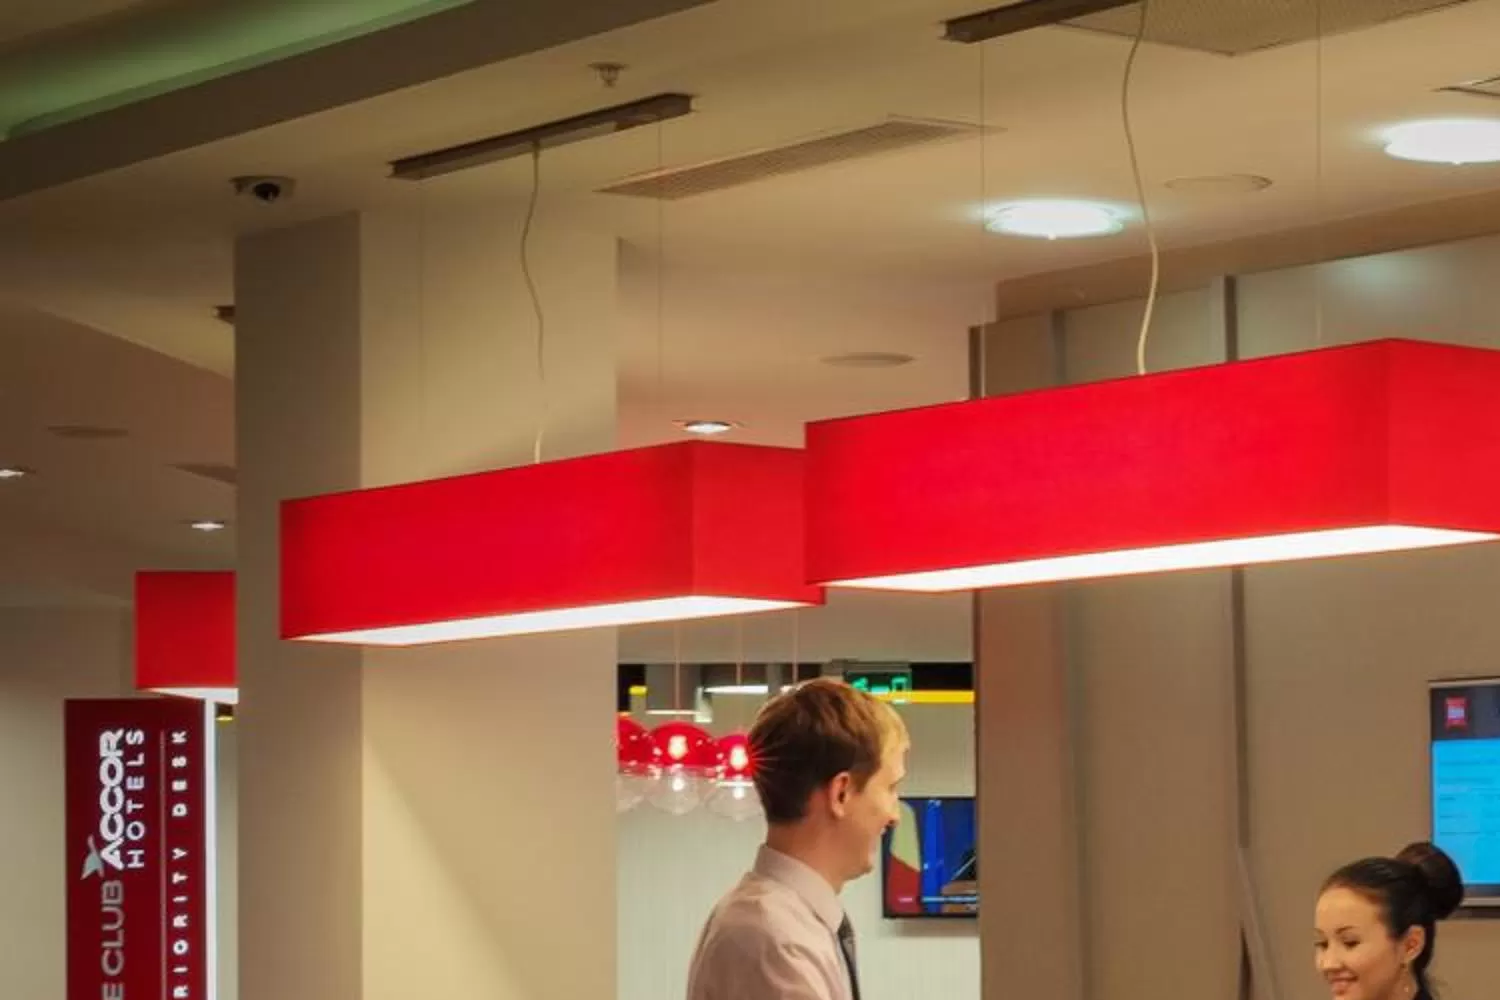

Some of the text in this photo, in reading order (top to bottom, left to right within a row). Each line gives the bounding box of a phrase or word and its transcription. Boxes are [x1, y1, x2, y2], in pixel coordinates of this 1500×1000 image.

[99, 728, 124, 870] ACCOR
[126, 730, 145, 868] HOTELS
[172, 731, 187, 817] DESK
[101, 880, 125, 976] CLUB
